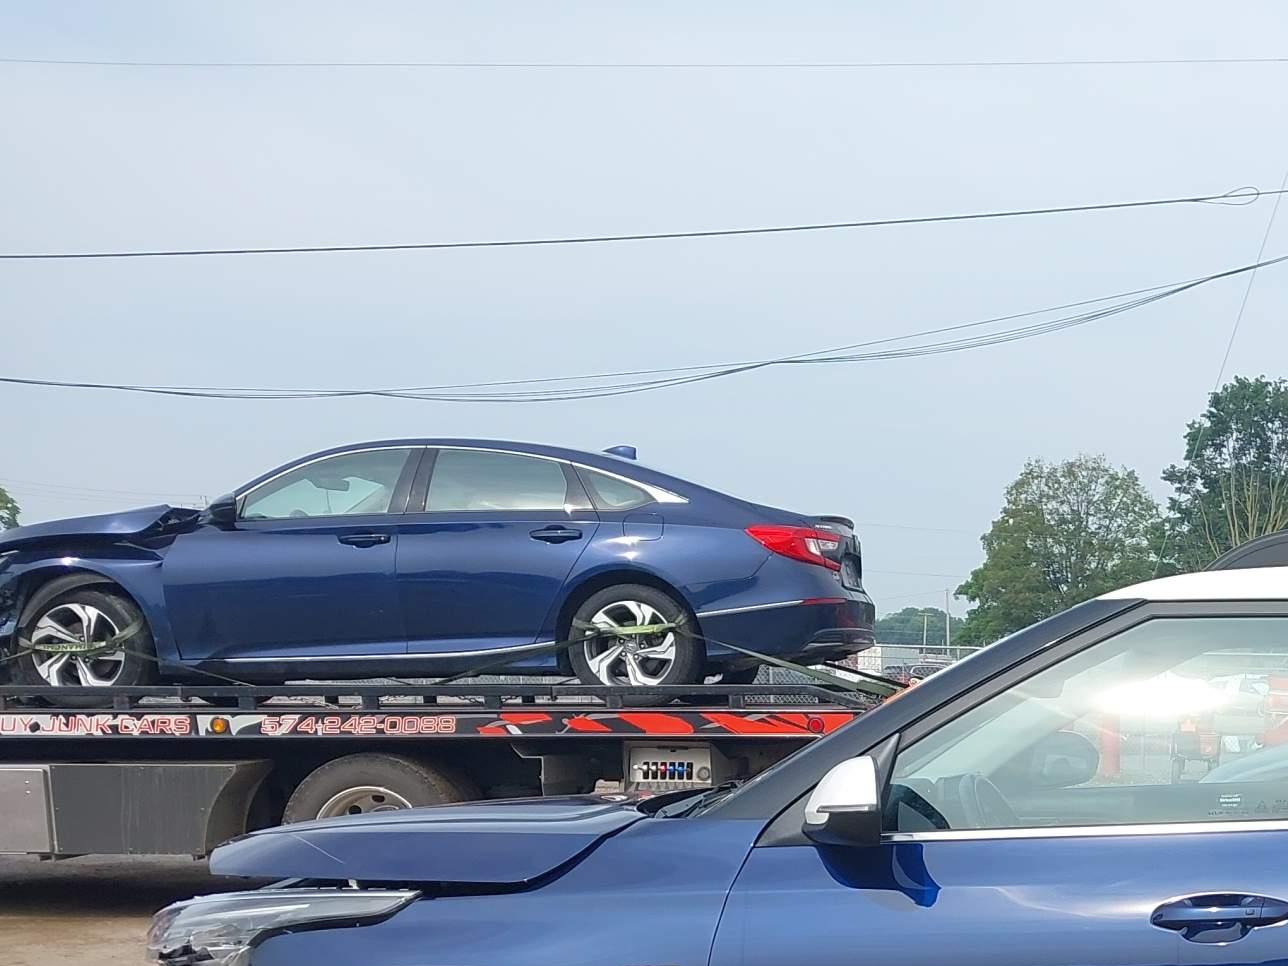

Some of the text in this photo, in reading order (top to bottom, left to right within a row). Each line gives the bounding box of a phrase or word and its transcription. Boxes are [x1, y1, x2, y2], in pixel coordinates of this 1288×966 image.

[42, 716, 112, 734] JUNK
[118, 716, 191, 734] CARS
[260, 716, 456, 734] 574-242-0088
